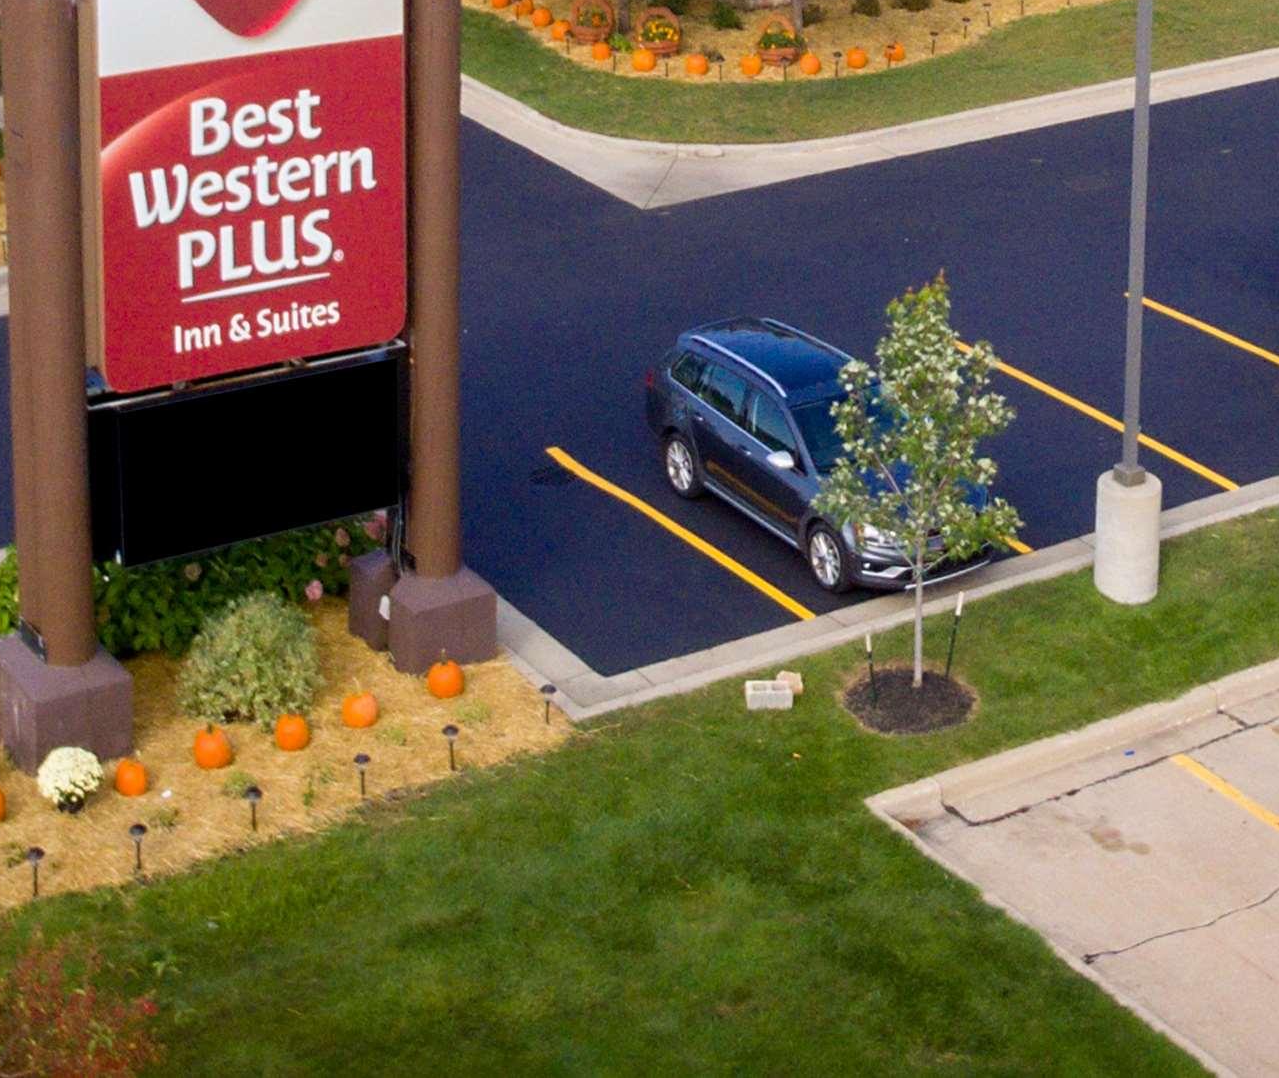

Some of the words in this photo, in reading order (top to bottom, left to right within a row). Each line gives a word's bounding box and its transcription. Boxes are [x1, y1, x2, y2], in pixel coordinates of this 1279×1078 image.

[189, 88, 322, 157] Best
[128, 146, 377, 228] Western
[173, 323, 223, 354] Inn
[228, 313, 252, 343] &
[257, 299, 340, 338] Suites
